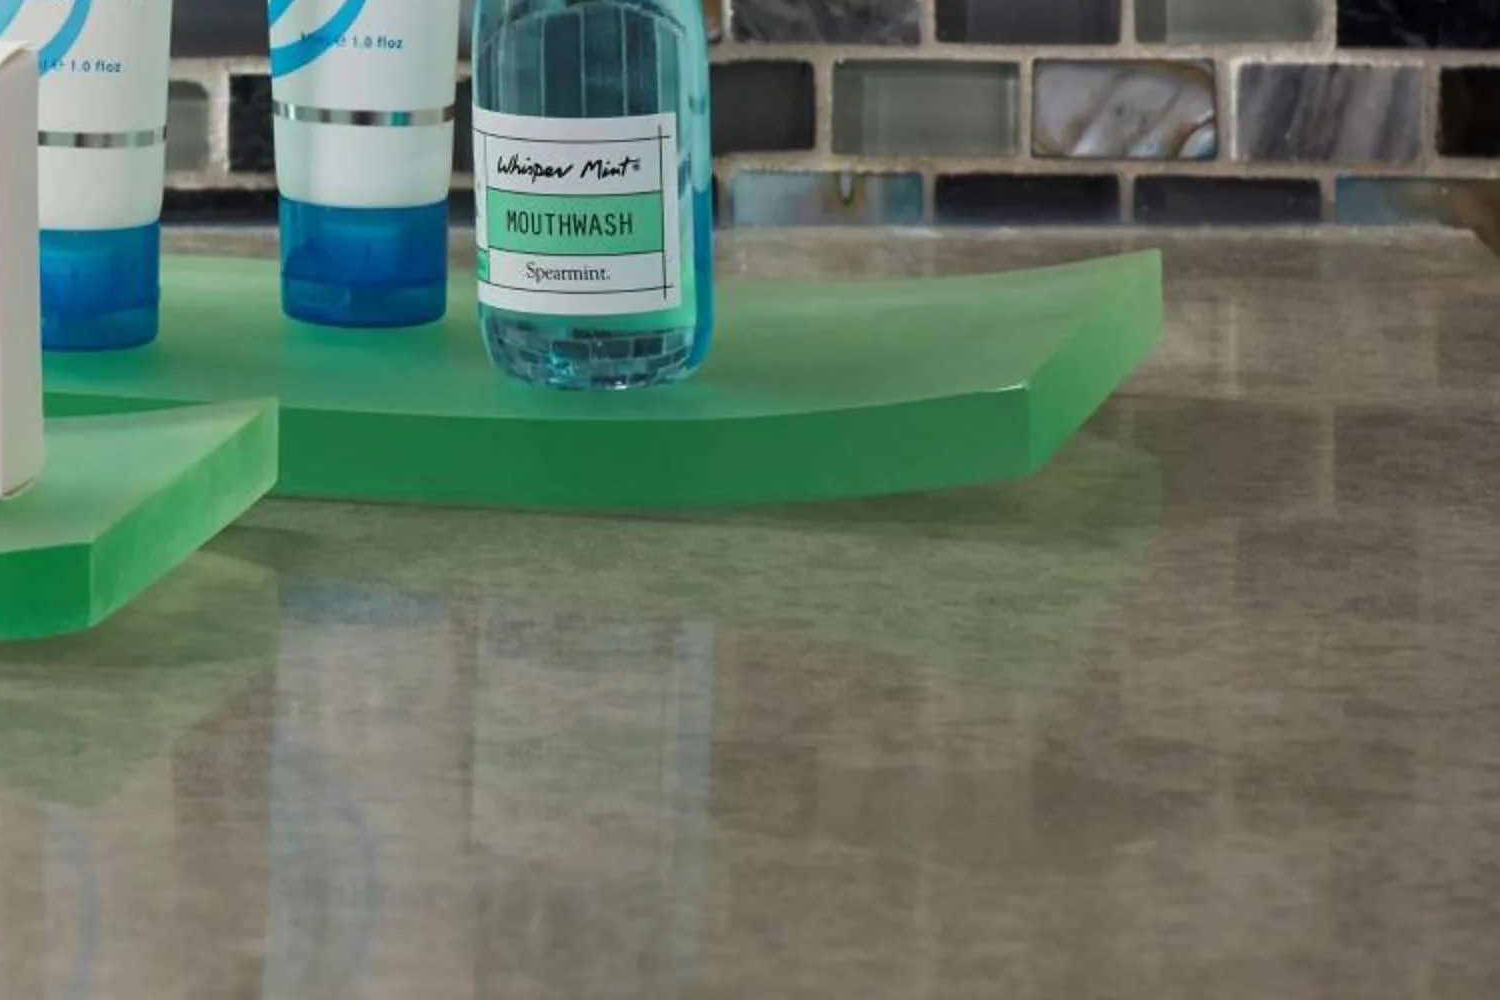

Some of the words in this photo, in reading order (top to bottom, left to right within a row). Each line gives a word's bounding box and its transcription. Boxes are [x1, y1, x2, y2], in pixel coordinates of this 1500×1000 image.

[498, 152, 574, 184] Whisper
[507, 210, 633, 237] MOUTHWASH
[526, 260, 610, 281] Spearmint.
